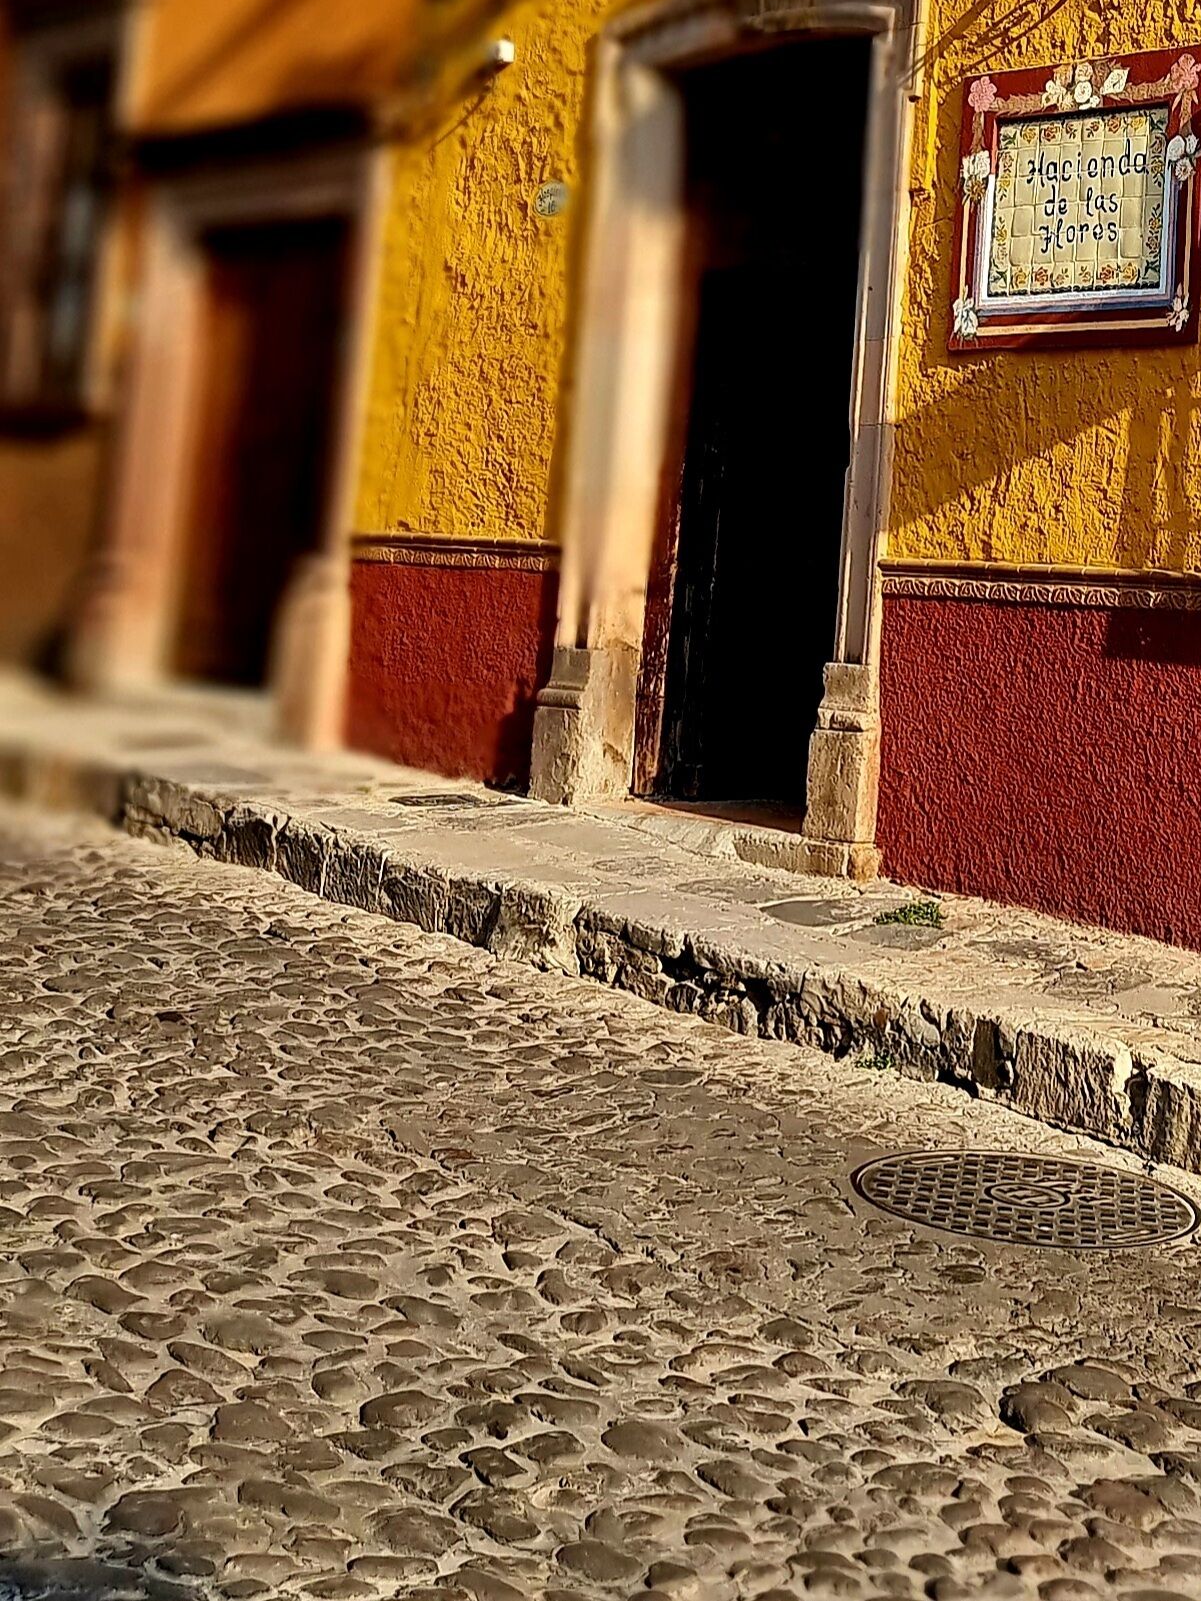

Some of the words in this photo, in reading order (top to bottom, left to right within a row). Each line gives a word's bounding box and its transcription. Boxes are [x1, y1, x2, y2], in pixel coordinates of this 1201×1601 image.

[1027, 138, 1149, 187] Hacienda
[1045, 184, 1068, 216] de
[1086, 187, 1118, 216] las
[1039, 218, 1118, 253] Flores
